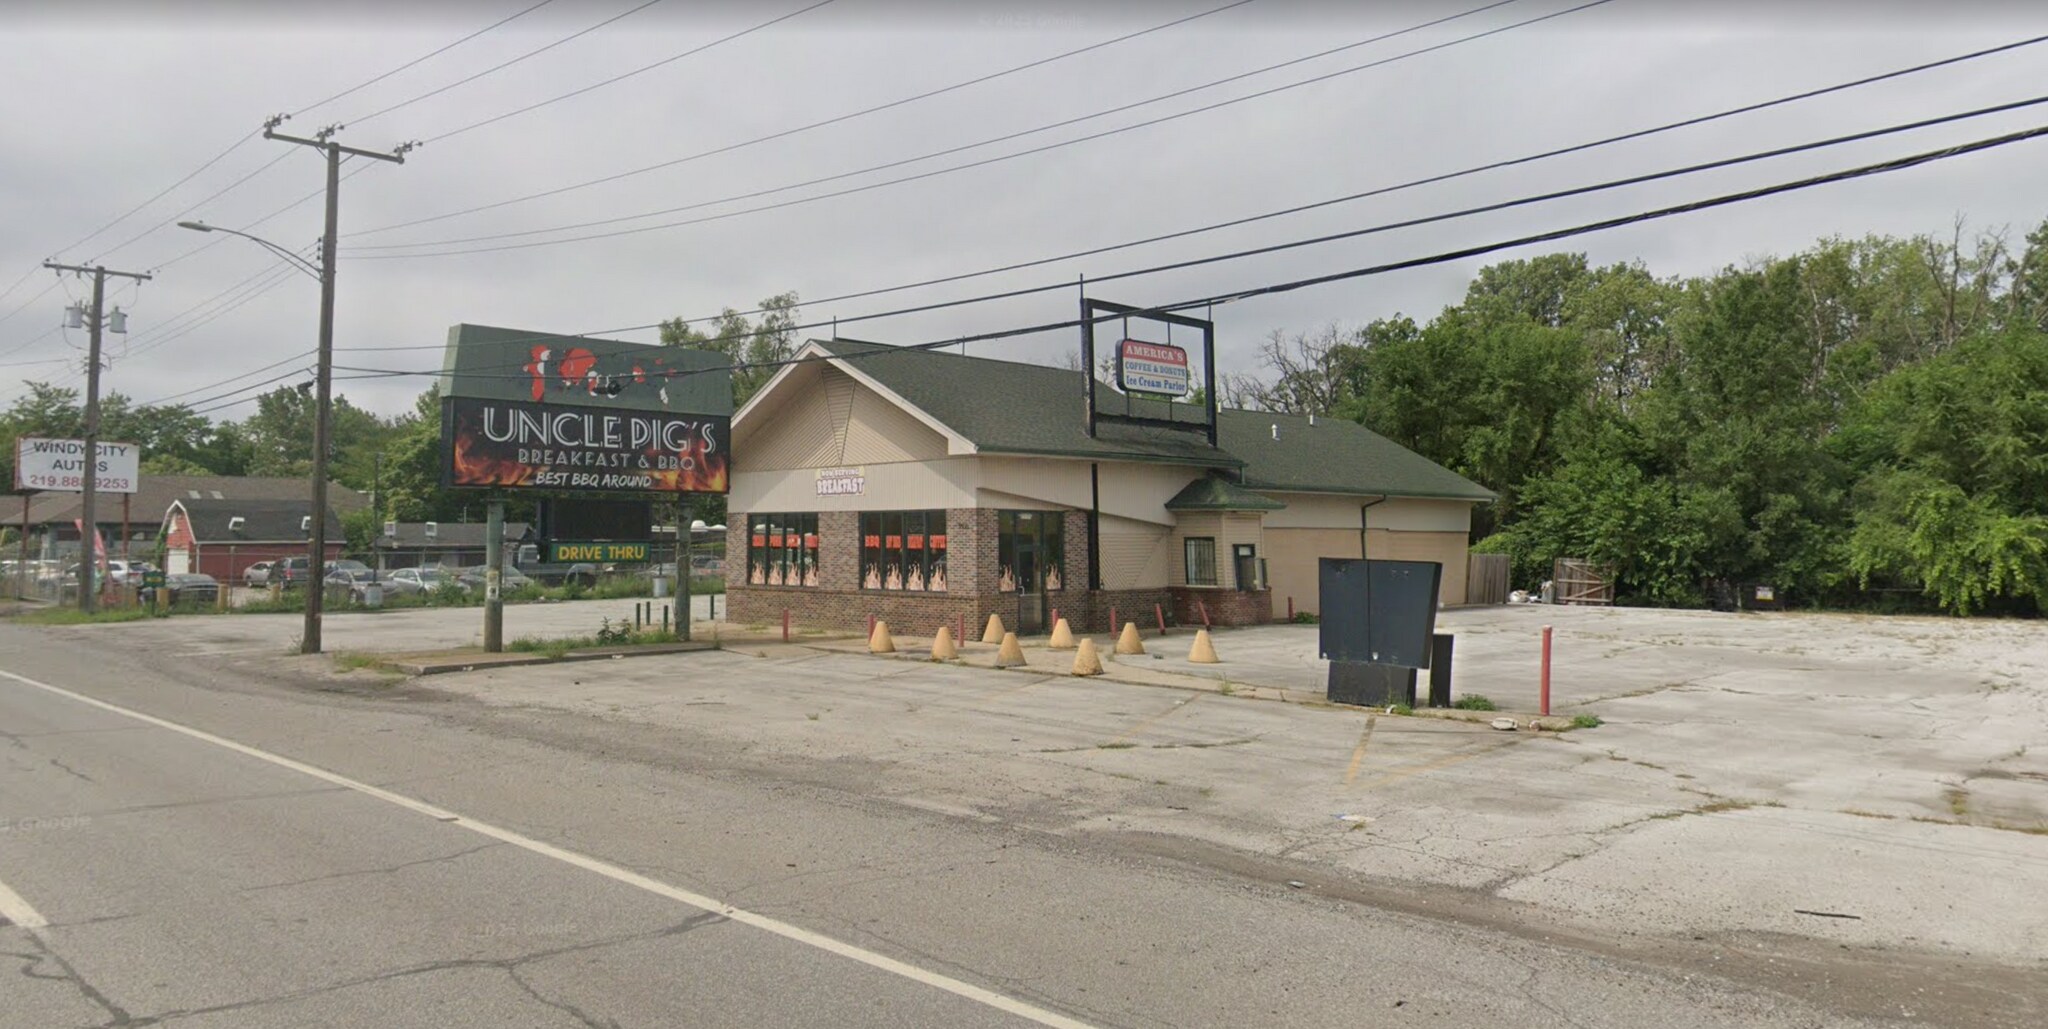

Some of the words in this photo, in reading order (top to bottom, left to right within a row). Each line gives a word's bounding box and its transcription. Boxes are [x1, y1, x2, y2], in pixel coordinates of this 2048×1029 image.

[1126, 345, 1184, 361] AMERICA'S
[1125, 361, 1152, 373] COFFEE
[1126, 374, 1137, 386] Ice
[1138, 376, 1162, 388] Cream
[1163, 379, 1186, 391] Parlor
[483, 407, 623, 449] UNCLE
[630, 417, 716, 454] PIG'S
[34, 442, 85, 455] WINDY
[52, 459, 108, 472] AUTS
[518, 449, 632, 468] BREAKFAST
[638, 455, 649, 469] &
[658, 456, 696, 472] BBQ
[535, 471, 569, 486] BEST
[571, 473, 599, 487] BBQ
[601, 474, 652, 489] AROUND
[816, 477, 865, 495] BREAKFAST
[558, 546, 603, 561] DRIVE
[608, 546, 645, 559] THRU
